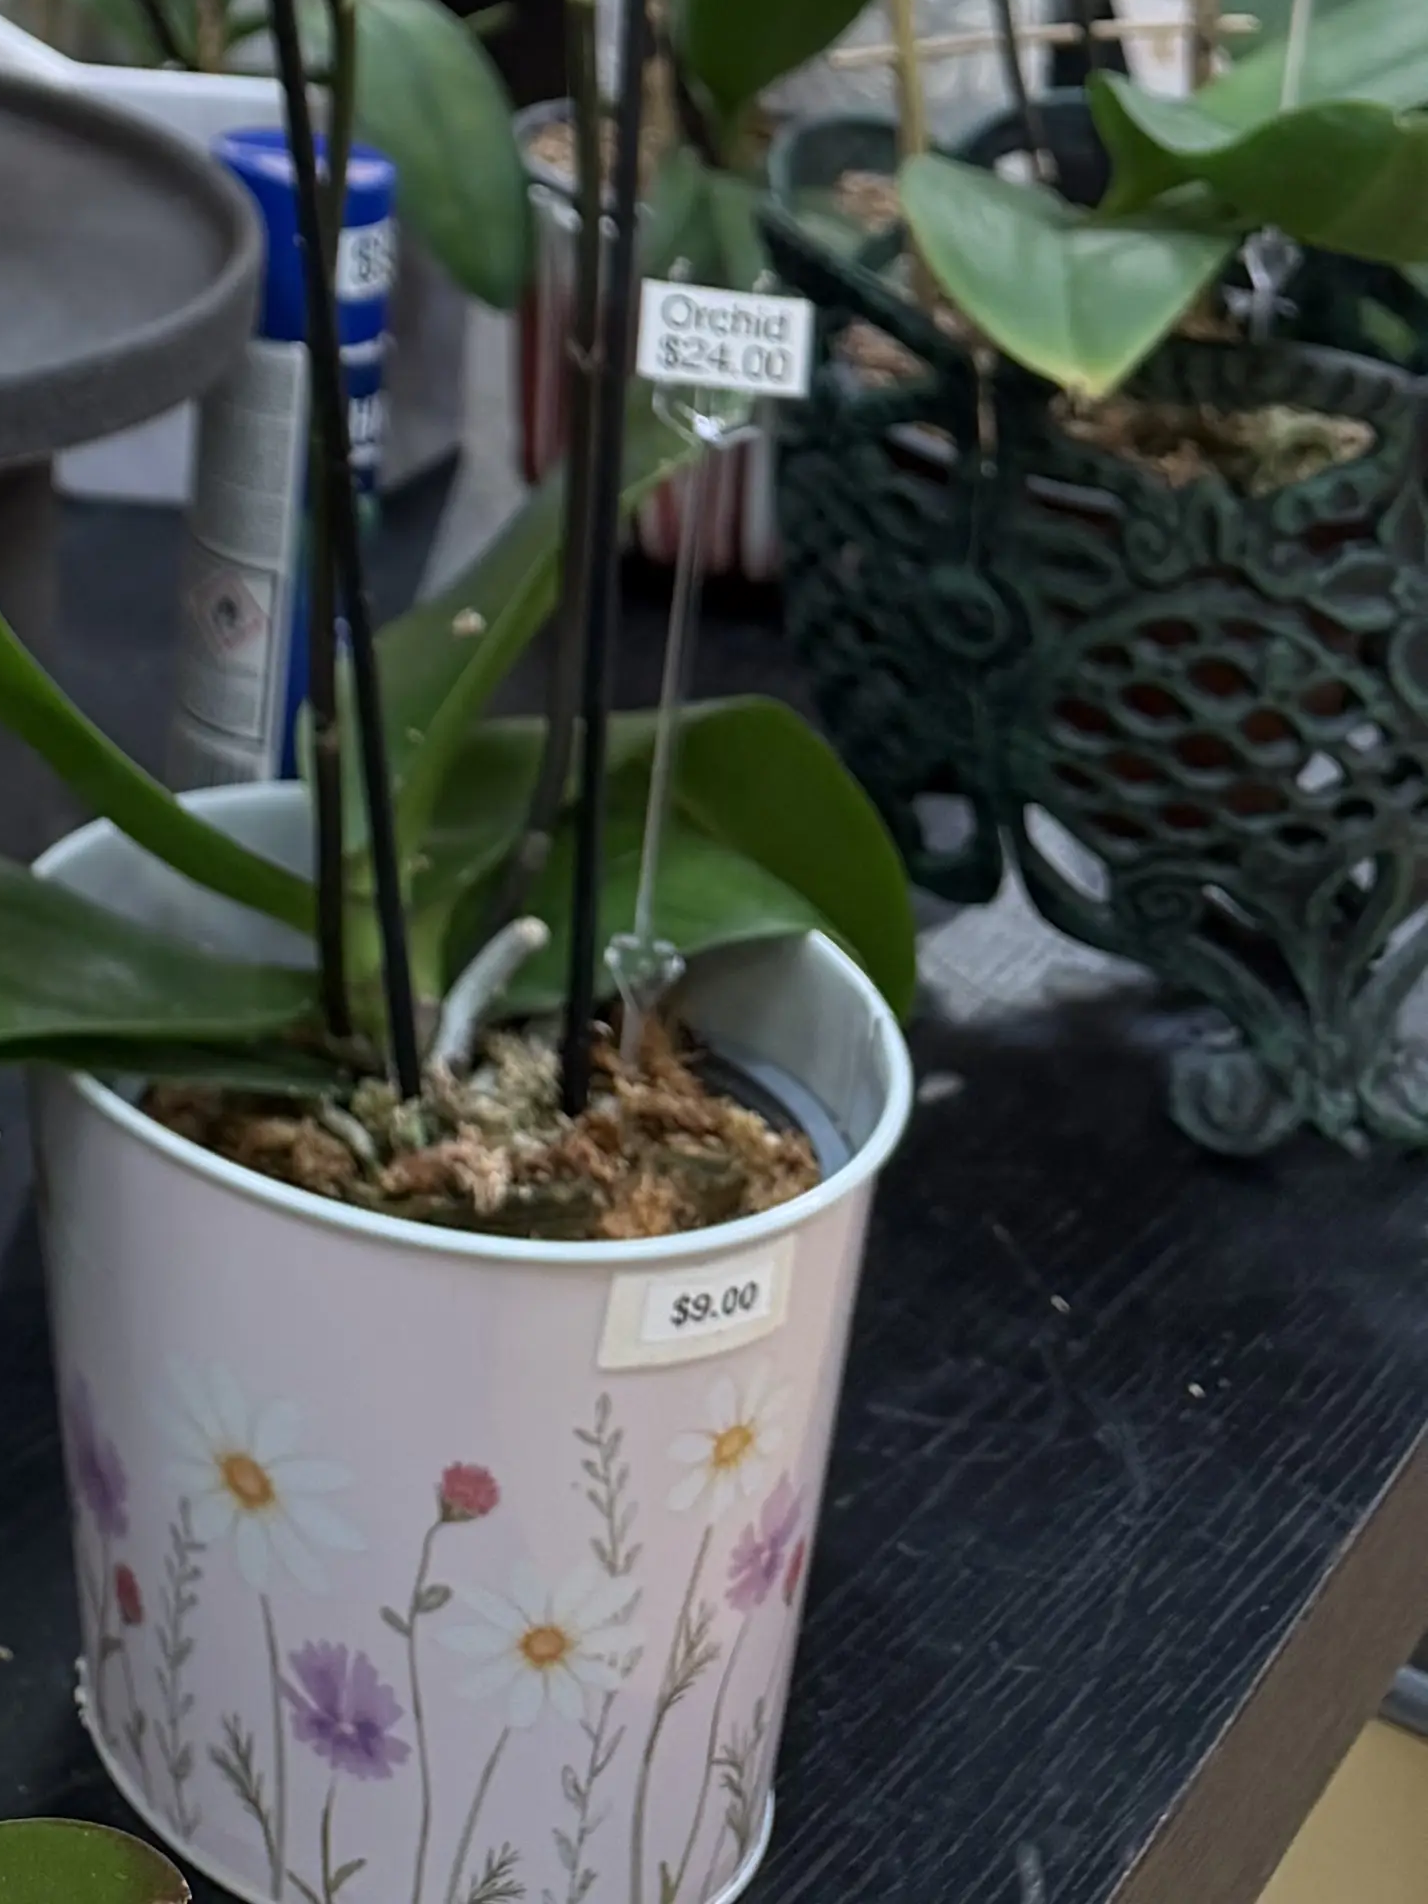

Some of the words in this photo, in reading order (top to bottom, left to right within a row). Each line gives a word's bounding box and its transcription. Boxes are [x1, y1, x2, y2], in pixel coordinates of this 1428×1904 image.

[661, 294, 789, 343] Orchid
[657, 334, 794, 382] $24.00
[670, 1280, 759, 1330] $9.00
